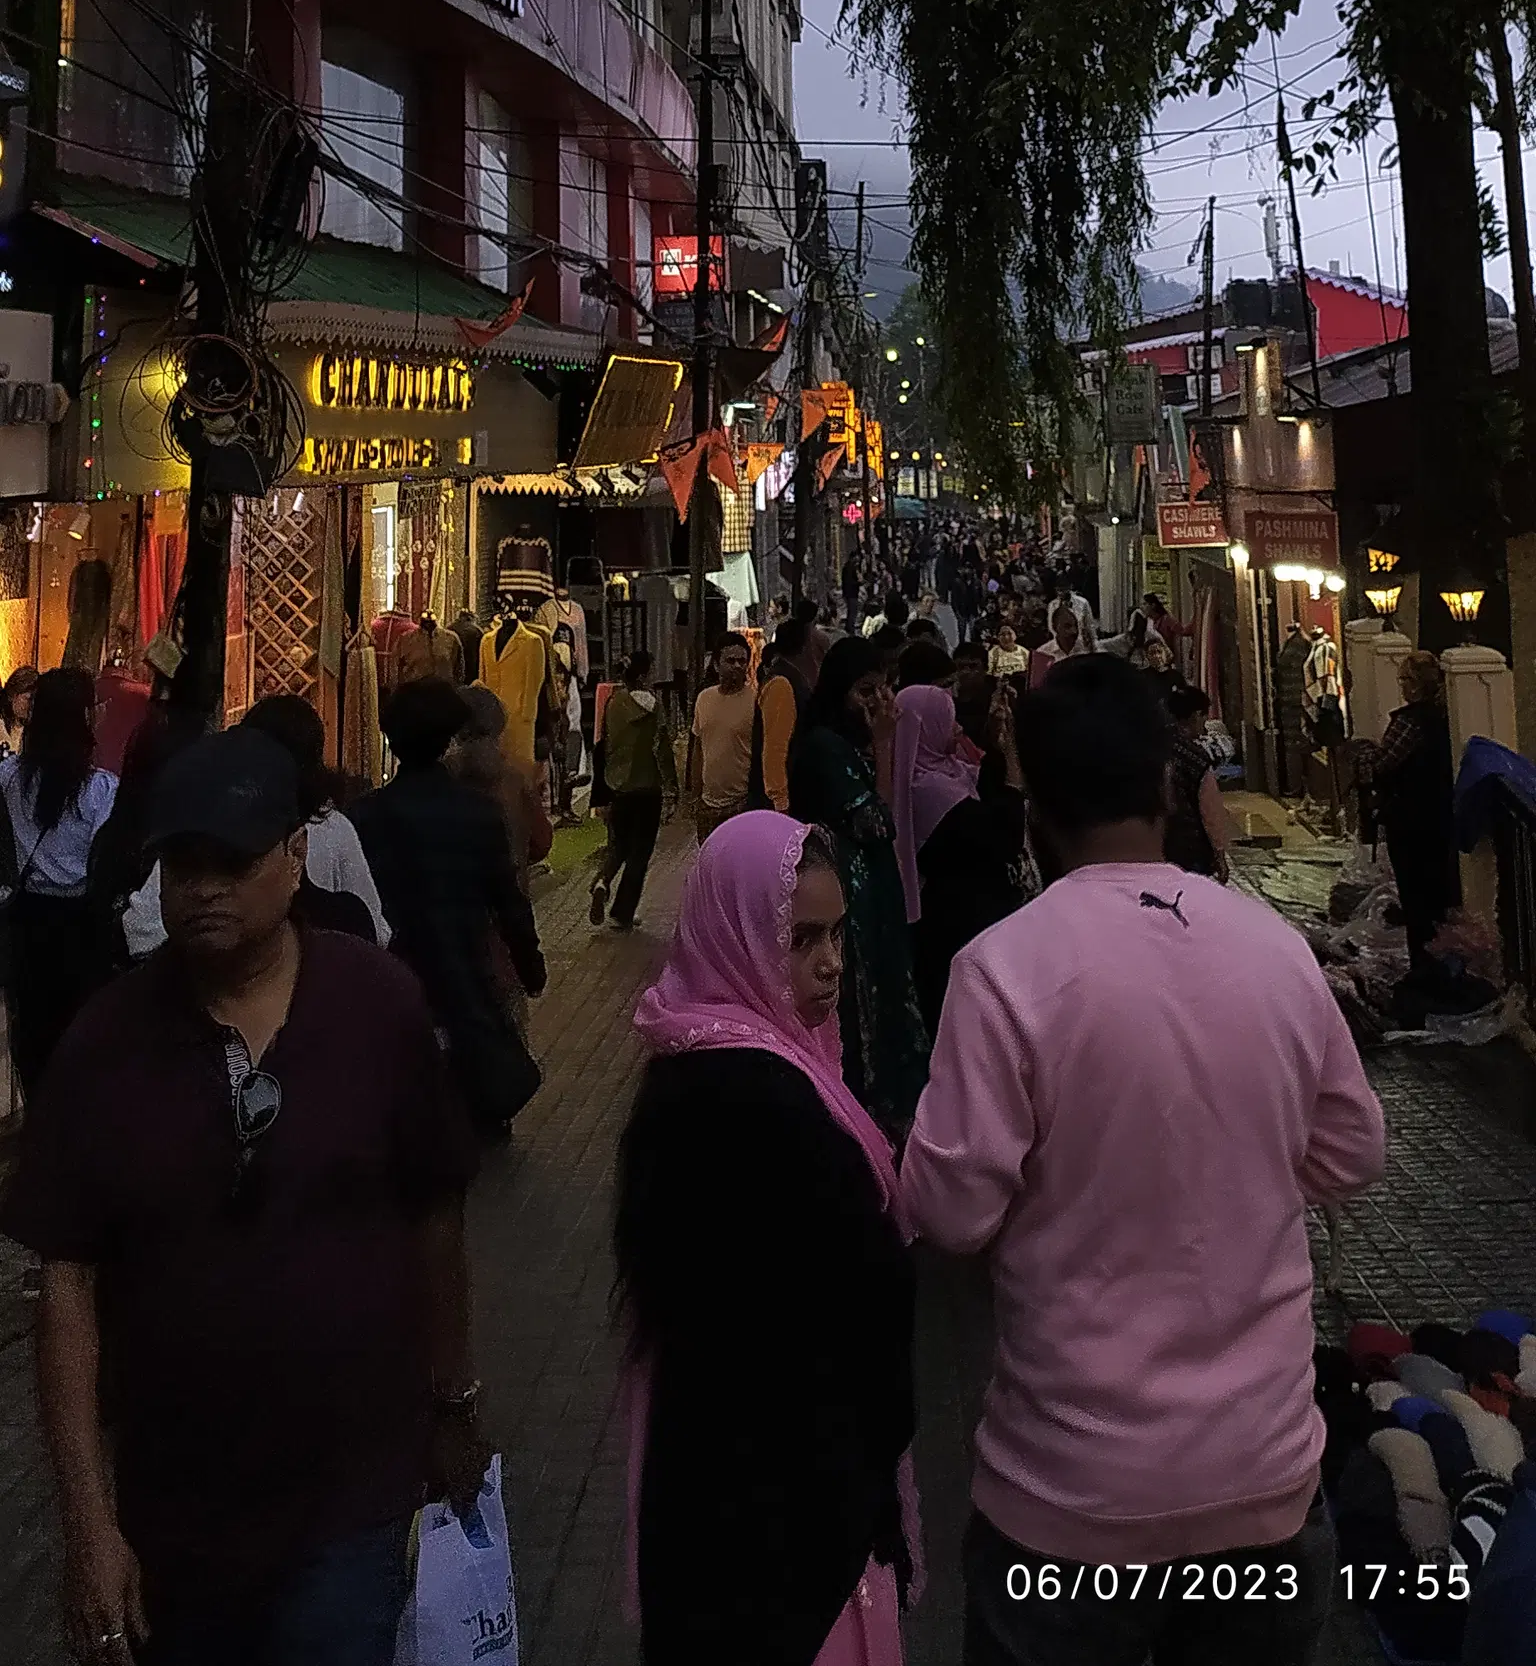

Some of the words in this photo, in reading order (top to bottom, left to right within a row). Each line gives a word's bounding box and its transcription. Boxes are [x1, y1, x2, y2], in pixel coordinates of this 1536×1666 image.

[1172, 524, 1217, 539] SHAWLS
[1255, 520, 1330, 539] PASHMINA
[1264, 542, 1323, 560] SHAWLS
